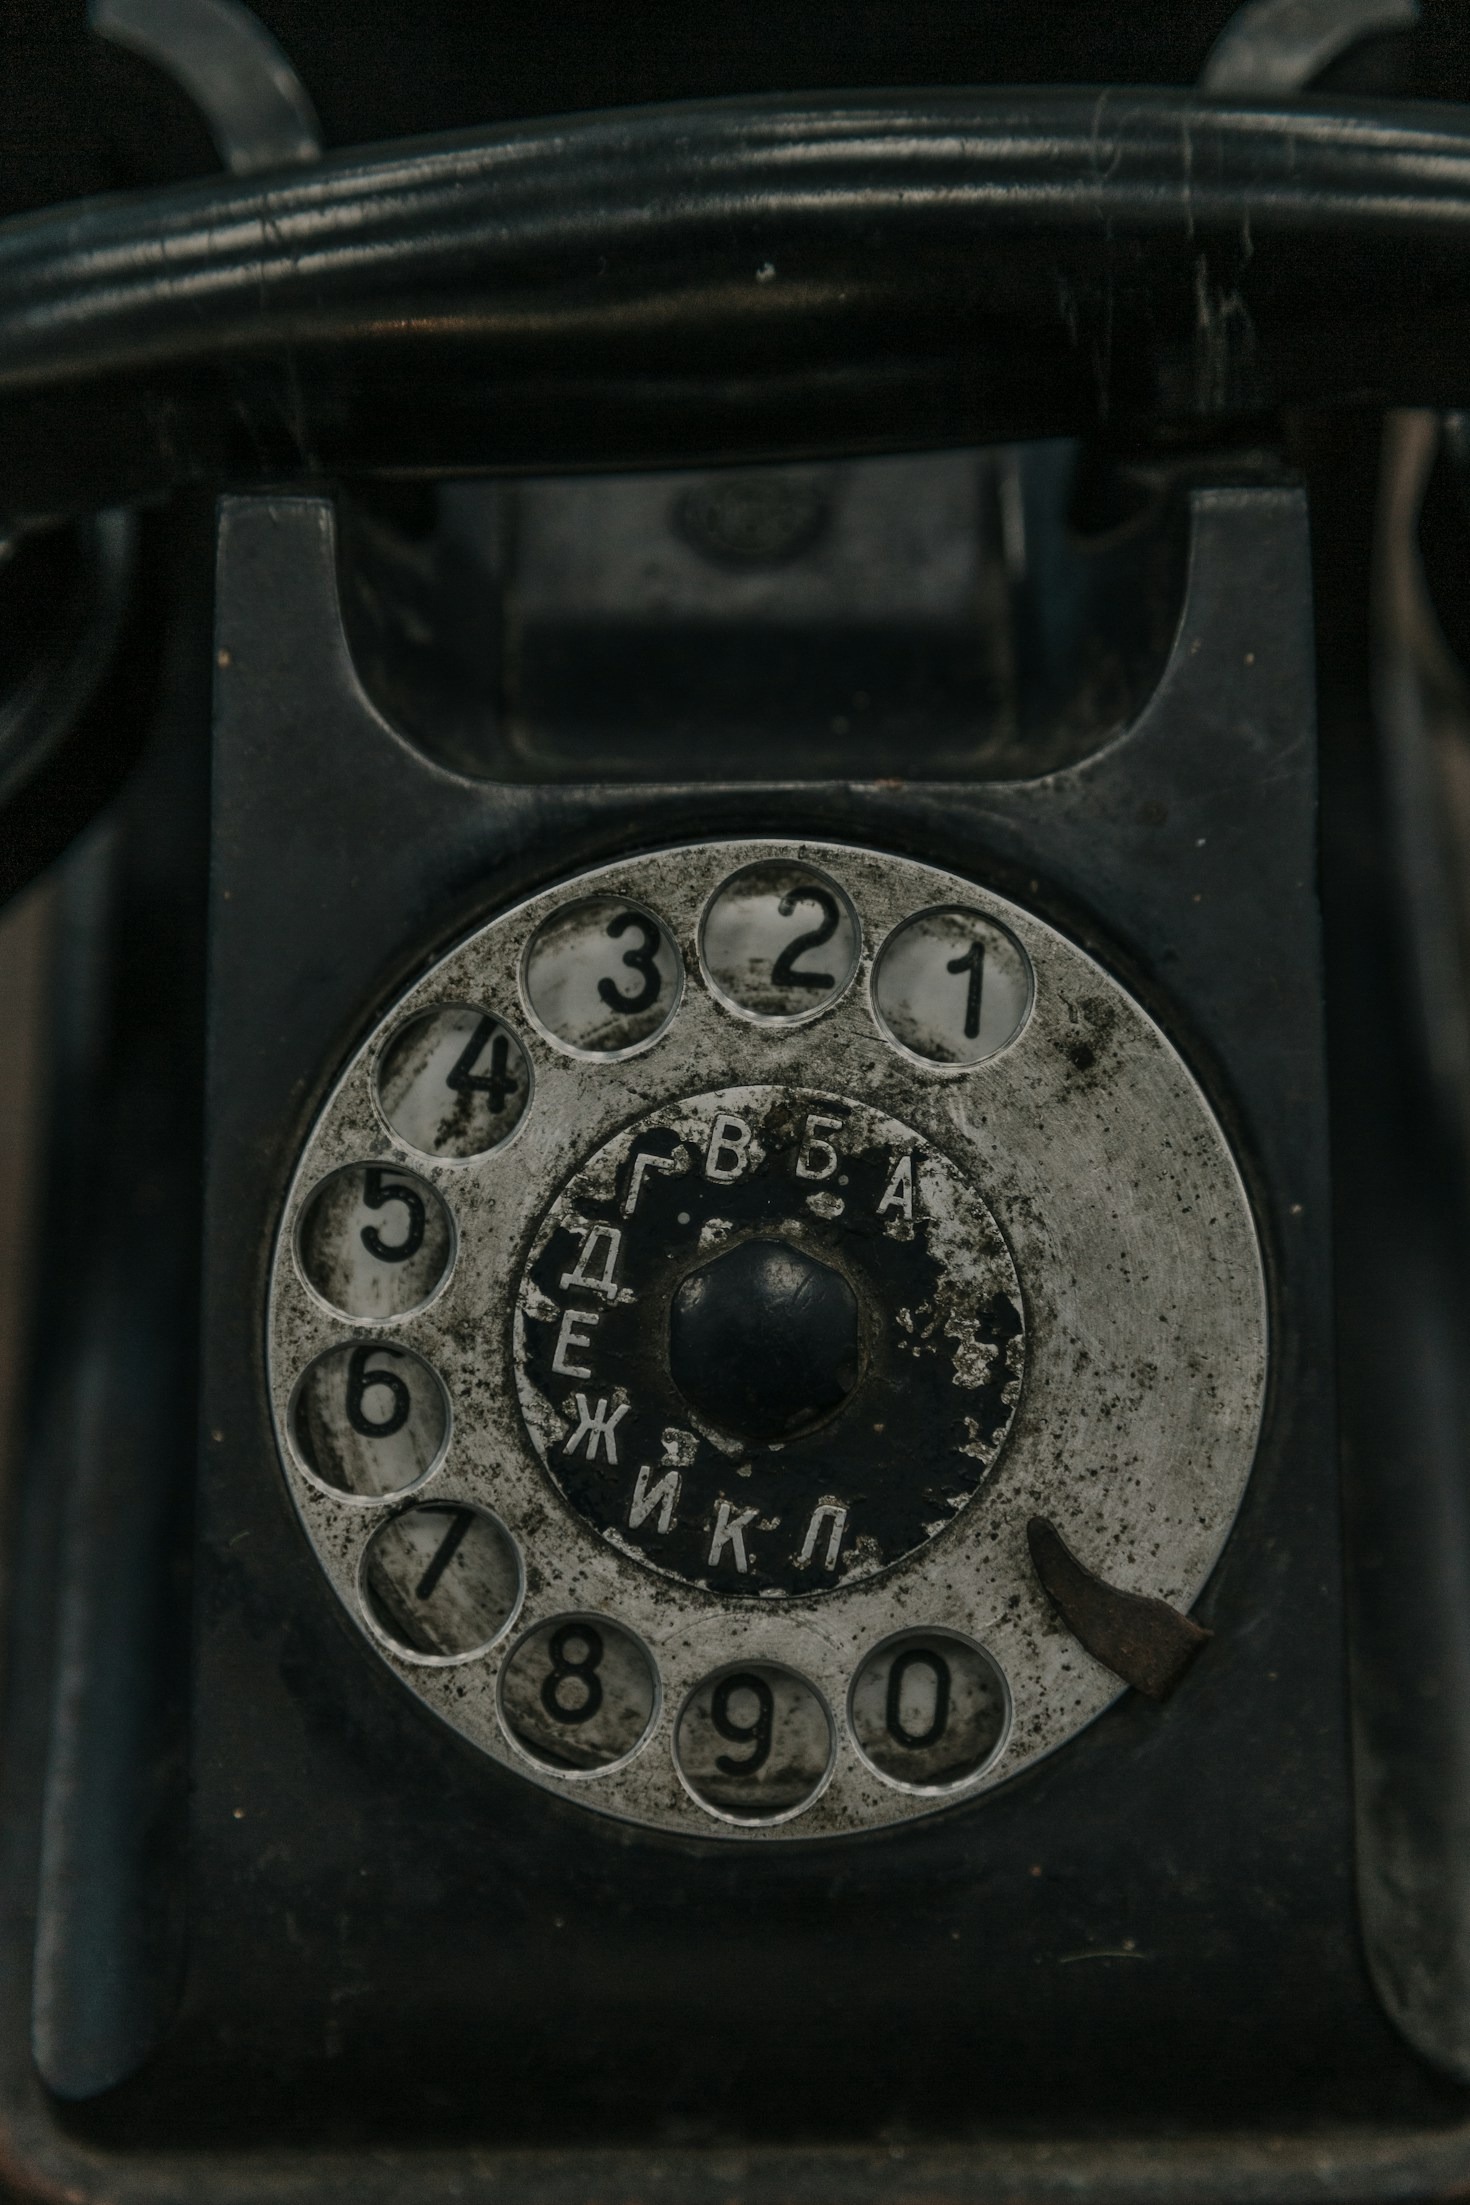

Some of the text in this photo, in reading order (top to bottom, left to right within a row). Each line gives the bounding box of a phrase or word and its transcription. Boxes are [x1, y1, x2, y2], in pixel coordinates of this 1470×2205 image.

[598, 911, 662, 1014] 3
[771, 886, 839, 989] 2
[947, 941, 984, 1039] 1
[447, 1016, 518, 1112] 4
[622, 1154, 674, 1219] Г
[706, 1114, 751, 1183] В
[796, 1115, 842, 1179] Б
[876, 1156, 914, 1220] А
[361, 1169, 424, 1262] 5
[559, 1225, 622, 1298] Д
[552, 1309, 599, 1379] Е
[347, 1346, 410, 1437] 6
[562, 1394, 631, 1465] Ж
[629, 1466, 681, 1534] И
[708, 1503, 756, 1573] К
[800, 1504, 848, 1571] Л
[414, 1509, 474, 1600] 7
[541, 1624, 602, 1724] 8
[886, 1649, 949, 1749] 0
[711, 1672, 773, 1776] 9
